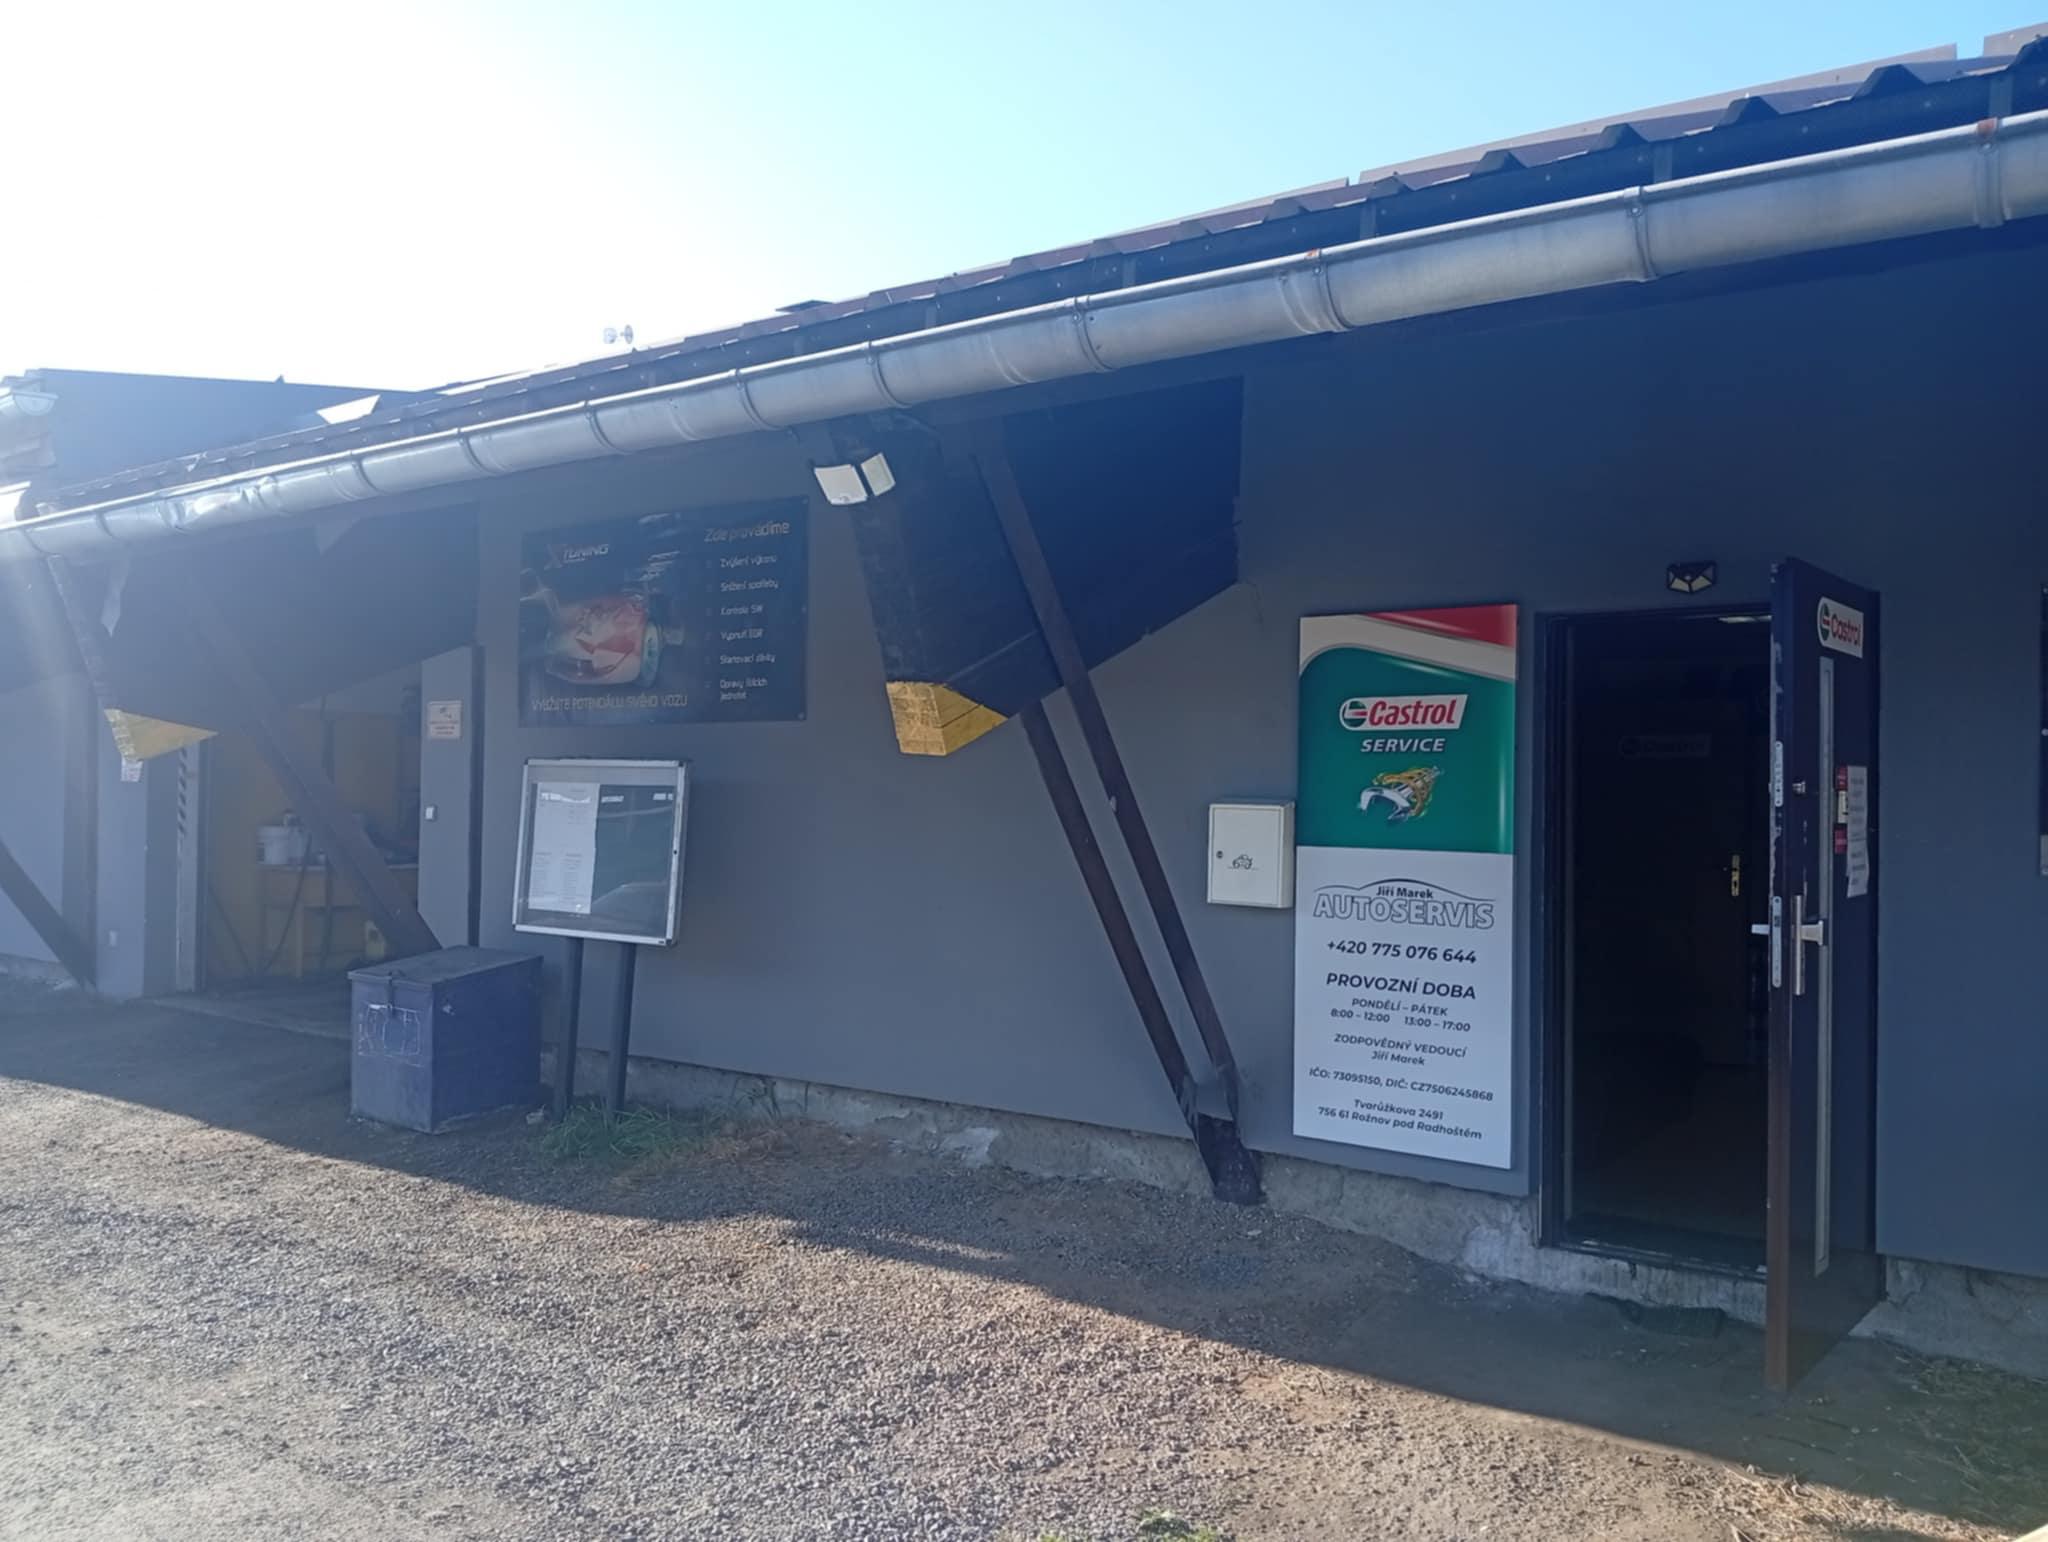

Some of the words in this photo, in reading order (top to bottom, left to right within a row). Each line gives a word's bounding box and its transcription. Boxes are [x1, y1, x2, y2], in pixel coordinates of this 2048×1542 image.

[1369, 700, 1457, 726] Castrol
[1361, 738, 1446, 752] SERVICE
[1376, 886, 1394, 897] Jiří
[1397, 888, 1433, 899] Marek
[1313, 894, 1494, 929] AUTOSERVIS
[1327, 940, 1367, 955] +420
[1372, 942, 1401, 958] 775
[1405, 945, 1438, 961] 076
[1442, 948, 1477, 964] 644
[1326, 972, 1419, 994] PROVOZNÍ
[1423, 981, 1476, 1000] DOBA
[1330, 1008, 1354, 1019] 8:00
[1363, 1011, 1390, 1023] 12:00
[1404, 1016, 1431, 1028] 13:00
[1442, 1021, 1471, 1032] 17:00
[1411, 1002, 1448, 1017] PÁTEK
[1371, 1050, 1389, 1062] Jiří
[1390, 1053, 1425, 1066] Marek
[1414, 1042, 1467, 1058] VEDOUCÍ
[1309, 1067, 1331, 1079] IČO:
[1386, 1076, 1408, 1089] DIČ:
[1410, 1081, 1493, 1102] CZ7506245868
[1318, 1106, 1338, 1119] 756
[1339, 1110, 1350, 1120] 61
[1351, 1111, 1391, 1127] Rožnov
[1393, 1117, 1415, 1131] pod
[1354, 1099, 1416, 1118] Tvarůžkova
[1418, 1108, 1443, 1120] 2491
